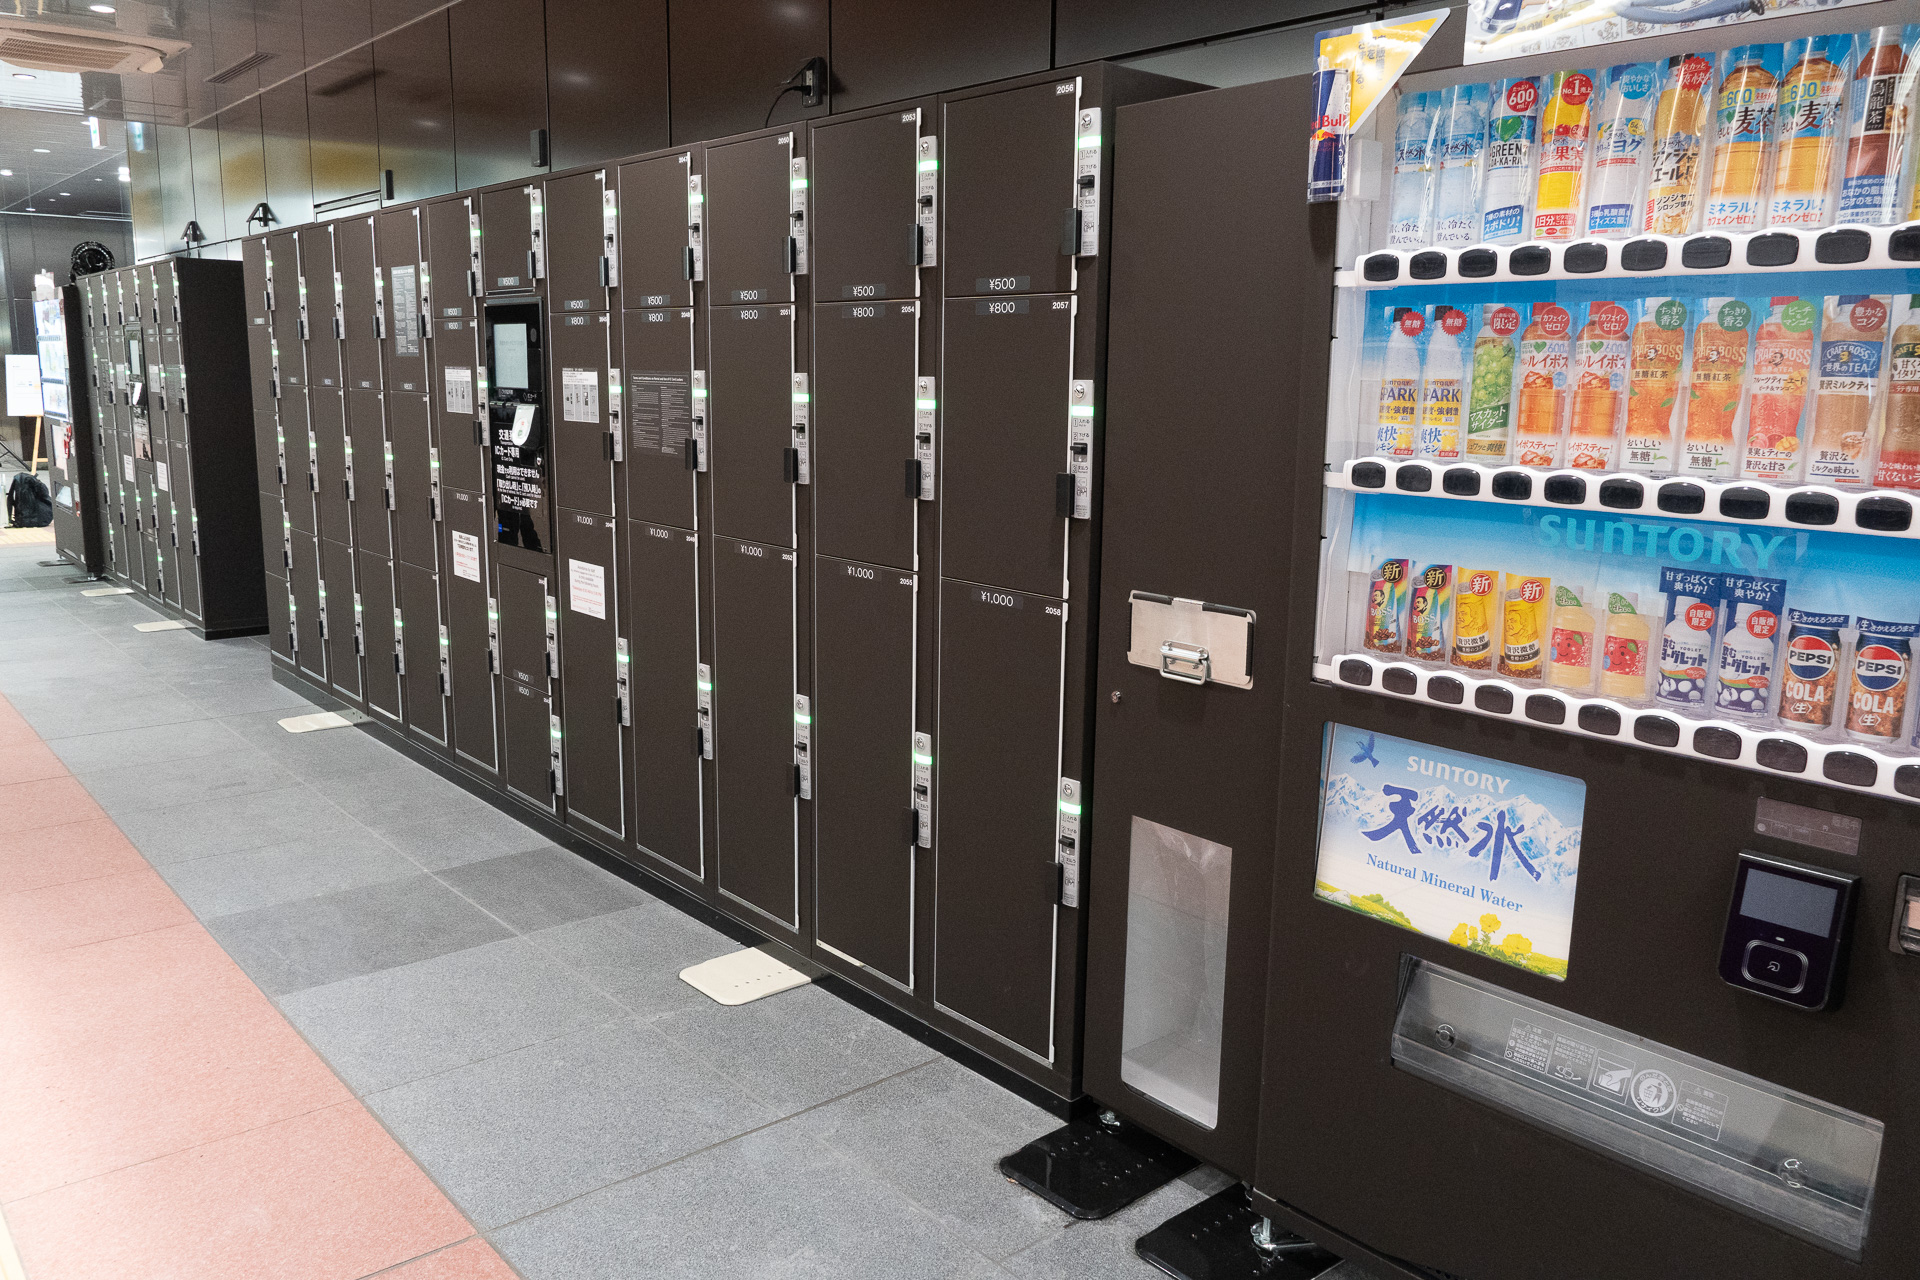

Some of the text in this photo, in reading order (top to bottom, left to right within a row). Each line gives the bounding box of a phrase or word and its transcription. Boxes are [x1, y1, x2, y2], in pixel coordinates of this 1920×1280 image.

[1056, 84, 1074, 94] 2056
[1622, 83, 1649, 93] おいしさ
[1791, 82, 1817, 100] 600
[1509, 88, 1535, 106] 600
[1727, 88, 1753, 106] 600
[902, 114, 916, 122] 2053
[777, 137, 790, 145] 2050
[1492, 143, 1522, 158] GREEN
[1709, 202, 1758, 215] ミネラル!
[1772, 199, 1825, 213] ミネラル!
[1707, 213, 1757, 225] カフェインゼロ!
[1771, 212, 1823, 225] カフェインゼロ!
[989, 278, 1016, 290] ¥500
[740, 290, 758, 300] ¥500
[853, 286, 875, 296] ¥500
[571, 300, 584, 309] ¥500
[648, 296, 663, 305] ¥500
[1052, 301, 1069, 310] 2057
[853, 307, 874, 317] ¥800
[989, 302, 1016, 314] ¥800
[1660, 306, 1683, 315] すっきり
[1722, 307, 1747, 316] すっきり
[1788, 306, 1813, 315] ピーチ
[1855, 307, 1883, 317] 豊かな
[649, 313, 664, 322] ¥800
[741, 310, 758, 320] ¥800
[1660, 315, 1680, 326] 香る
[571, 317, 584, 326] ¥800
[1403, 319, 1421, 328] 無糖
[1445, 317, 1463, 327] 無糖
[1493, 318, 1517, 330] 限定
[1545, 322, 1565, 331] ゼロ!
[1603, 322, 1623, 331] ゼロ!
[1723, 316, 1744, 327] 香る
[1783, 317, 1813, 327] マンゴー
[1856, 318, 1878, 328] コク
[1656, 344, 1683, 360] BOSS
[1719, 346, 1747, 363] BOSS
[1782, 347, 1811, 365] BOSS
[1849, 345, 1871, 359] BOSS
[1825, 363, 1868, 373] 世界のTEA
[1380, 387, 1417, 402] PARK
[1423, 388, 1461, 402] PARK
[1470, 406, 1506, 422] マスカット
[1471, 416, 1504, 431] サイダー
[1627, 438, 1662, 448] おいしい
[1686, 442, 1724, 452] おいしい
[1629, 451, 1650, 462] 無糖
[1747, 447, 1792, 458] 果実とティーの
[1819, 450, 1849, 461] 贅沢な
[1690, 456, 1712, 467] 無糖
[1811, 465, 1860, 475] ミルクの味わい
[577, 515, 593, 526] ¥1,000
[650, 527, 669, 539] ¥1,000
[740, 544, 763, 557] ¥1,000
[847, 565, 874, 580] ¥1,000
[1383, 563, 1400, 580] 新
[900, 578, 913, 586] 2055
[1426, 569, 1444, 586] 新
[1666, 571, 1717, 586] 甘ずっぱくて
[1472, 576, 1491, 593] 新
[1674, 583, 1708, 595] 爽やか!
[1726, 577, 1780, 593] 甘ずっぱくて
[1522, 582, 1542, 600] 新
[1734, 589, 1771, 602] 爽やか!
[981, 591, 1014, 607] ¥1,000
[1045, 606, 1061, 616] 2058
[1370, 606, 1392, 616] BOSS
[1689, 609, 1712, 619] 自販機
[1413, 613, 1436, 624] BOSS
[1691, 618, 1707, 627] 限定
[1751, 616, 1775, 626] 自販機
[1753, 625, 1769, 635] 限定
[1789, 650, 1832, 665] PEPSI
[1857, 660, 1902, 676] PEPSI
[1786, 681, 1824, 703] COLA
[1853, 691, 1894, 715] COLA
[1361, 784, 1542, 882] 天然水
[1366, 853, 1523, 913] Natural Mineral Water
